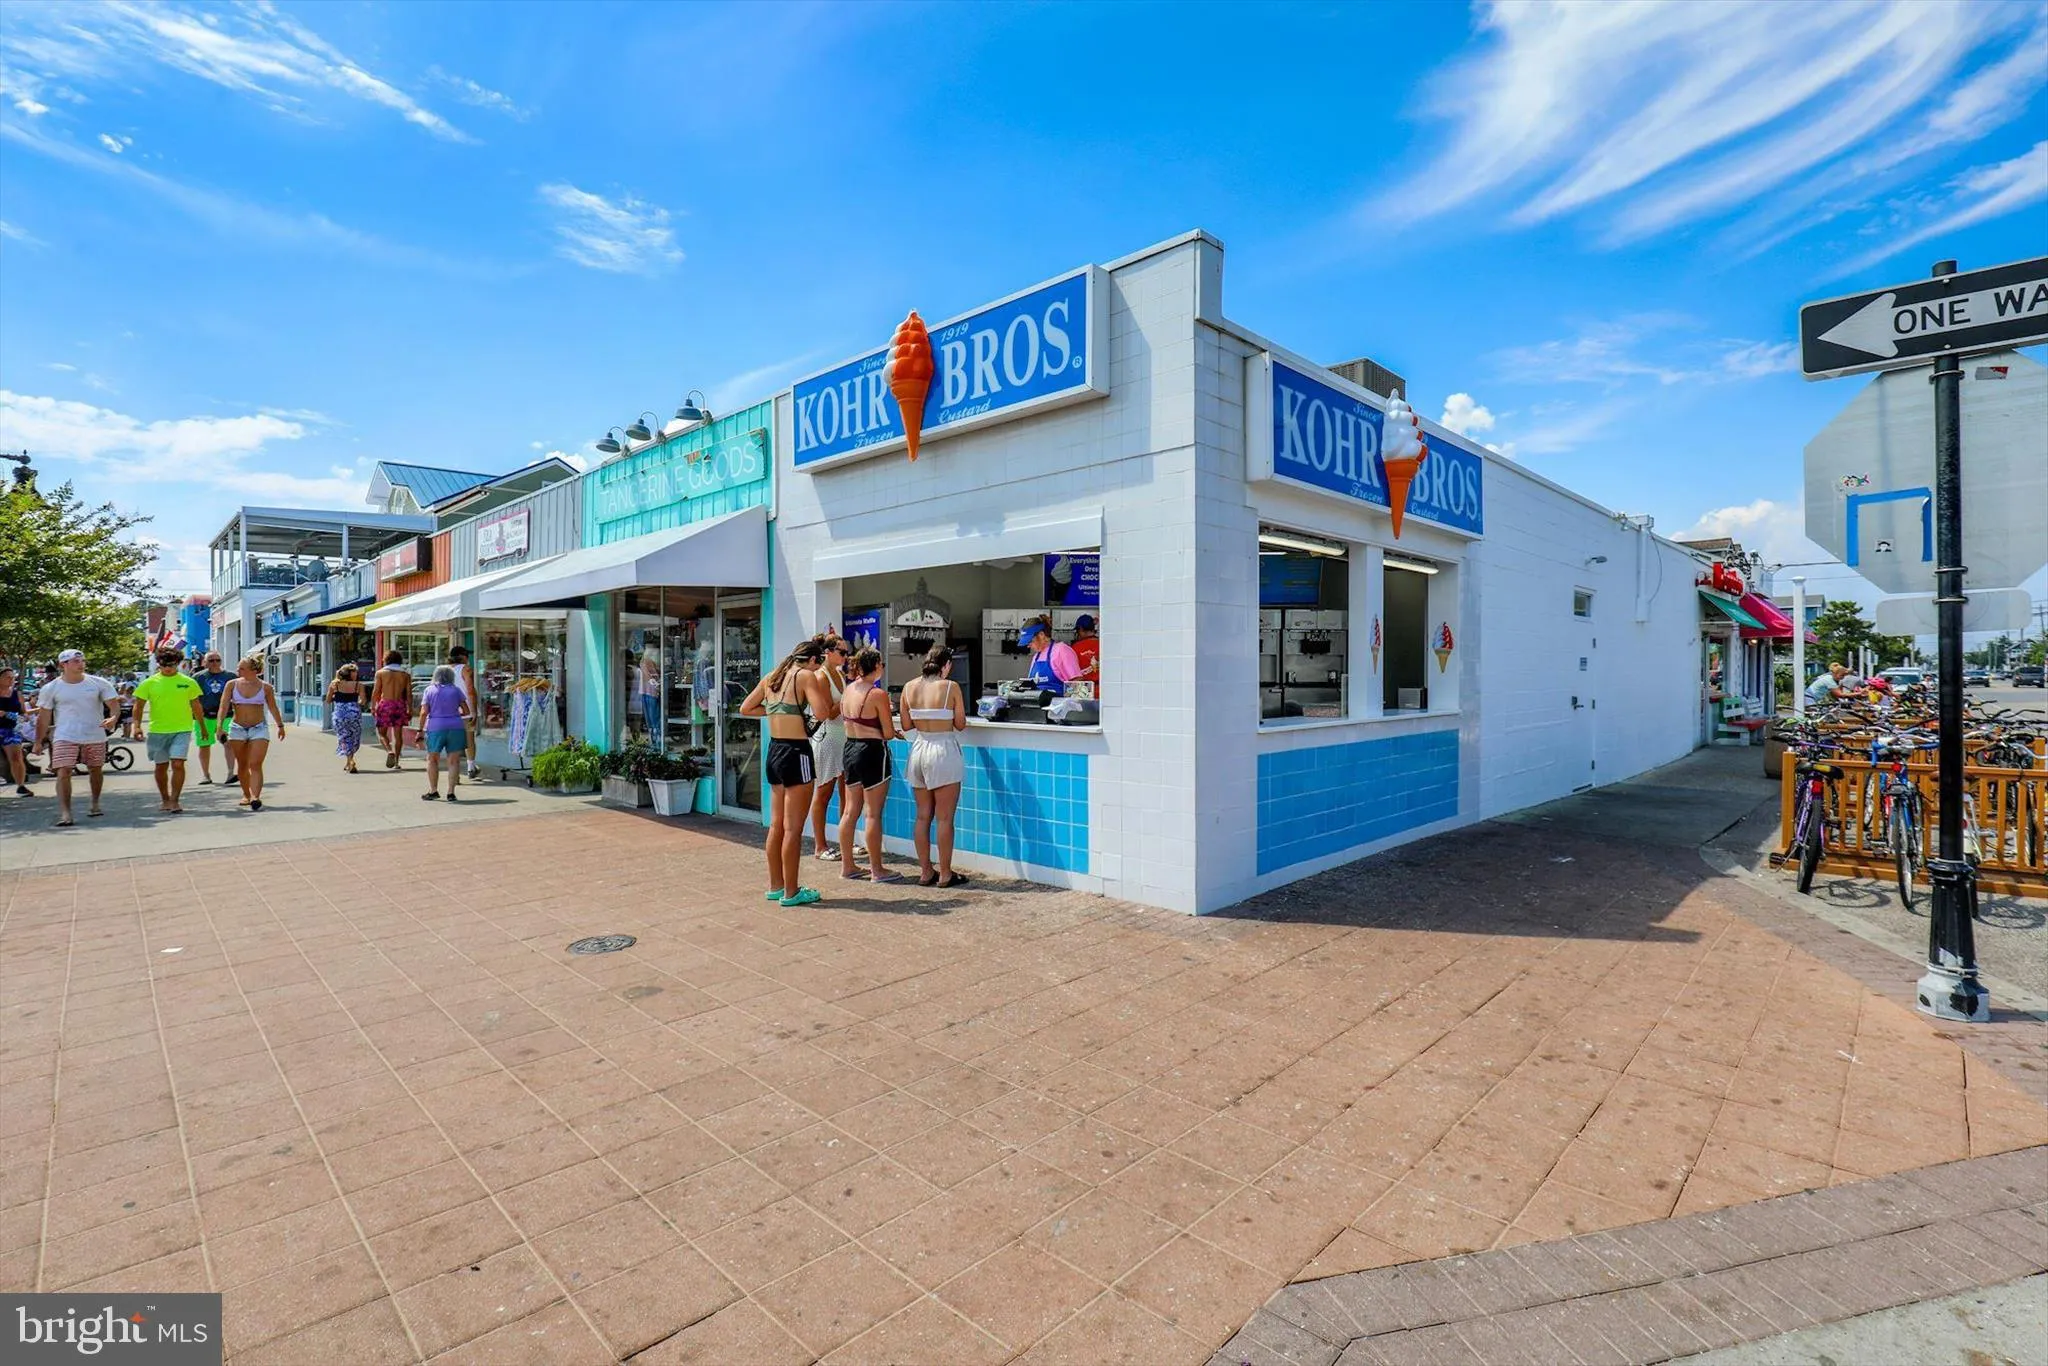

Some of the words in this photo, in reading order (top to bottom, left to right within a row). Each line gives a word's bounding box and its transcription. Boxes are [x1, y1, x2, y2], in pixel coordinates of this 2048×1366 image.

[941, 322, 969, 343] 1919
[1893, 298, 1971, 334] ONE
[796, 369, 891, 452] KOHR
[854, 431, 895, 449] Frozen
[938, 399, 992, 424] Custard
[1353, 402, 1379, 422] Since
[1278, 384, 1381, 488] KOHR
[600, 464, 685, 516] TANGERINE
[687, 441, 757, 490] GOODS
[1350, 482, 1385, 505] Frozen
[1410, 502, 1440, 521] Custard
